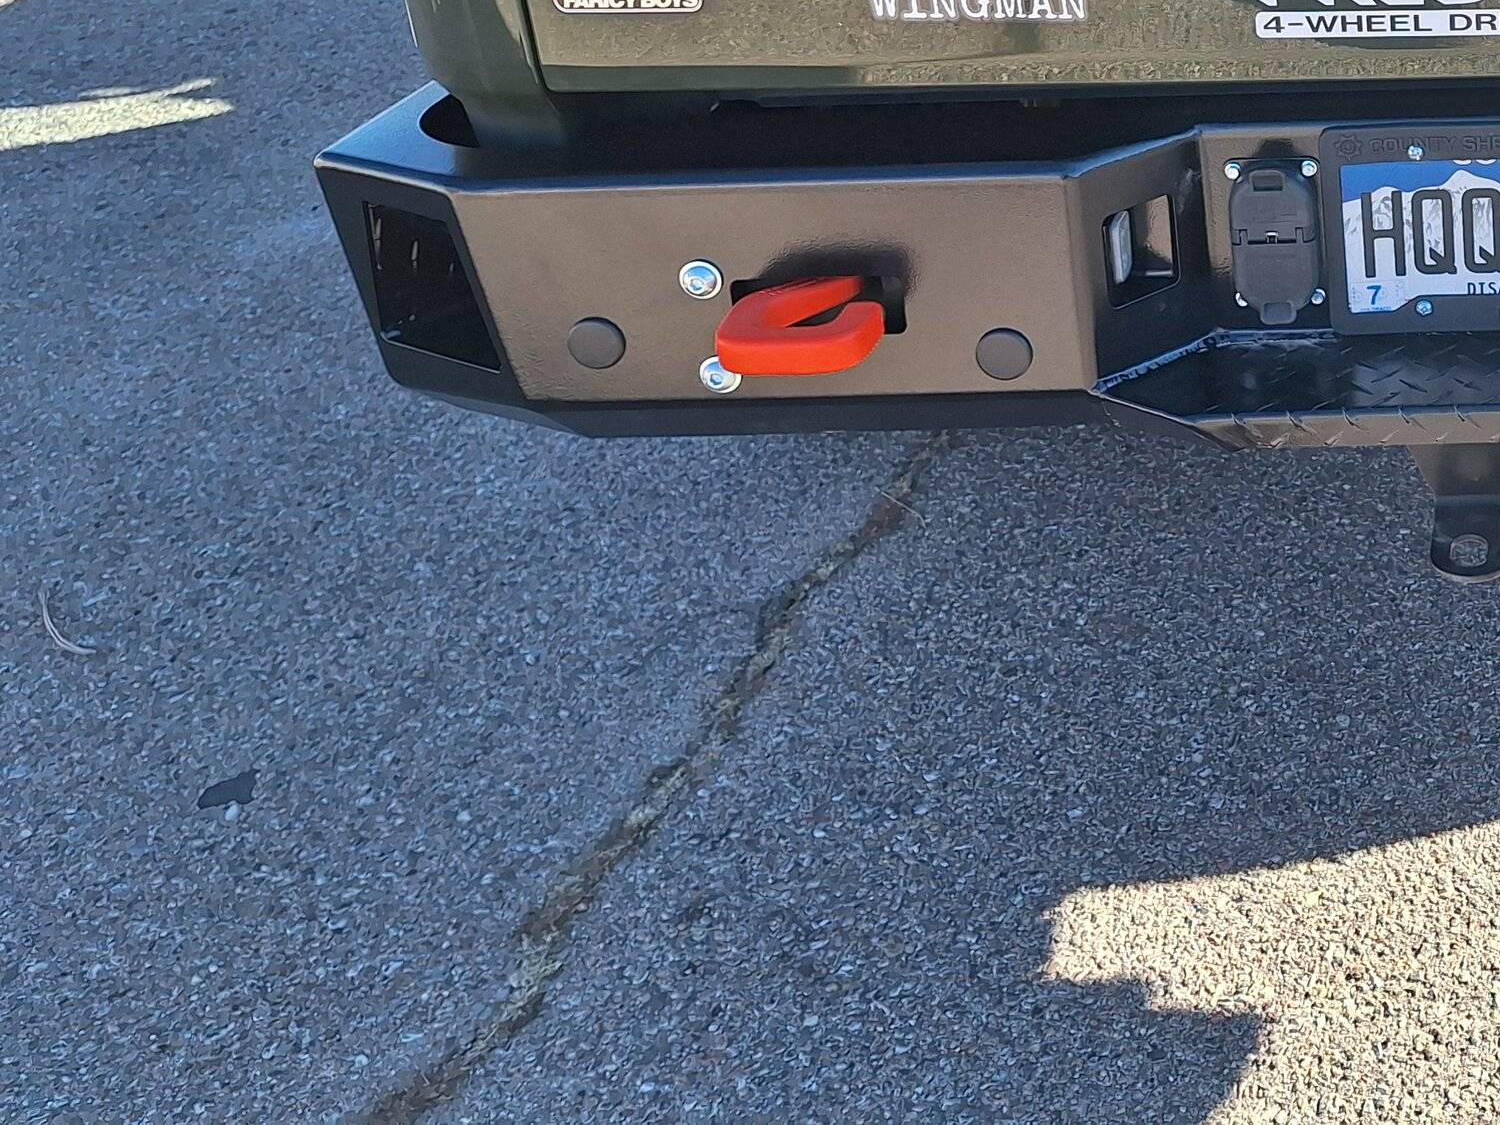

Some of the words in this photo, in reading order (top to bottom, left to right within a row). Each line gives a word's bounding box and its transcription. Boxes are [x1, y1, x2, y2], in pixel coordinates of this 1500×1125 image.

[1262, 13, 1433, 34] 4-WHEEL
[1370, 136, 1456, 153] COUNTY
[1366, 284, 1382, 305] 7
